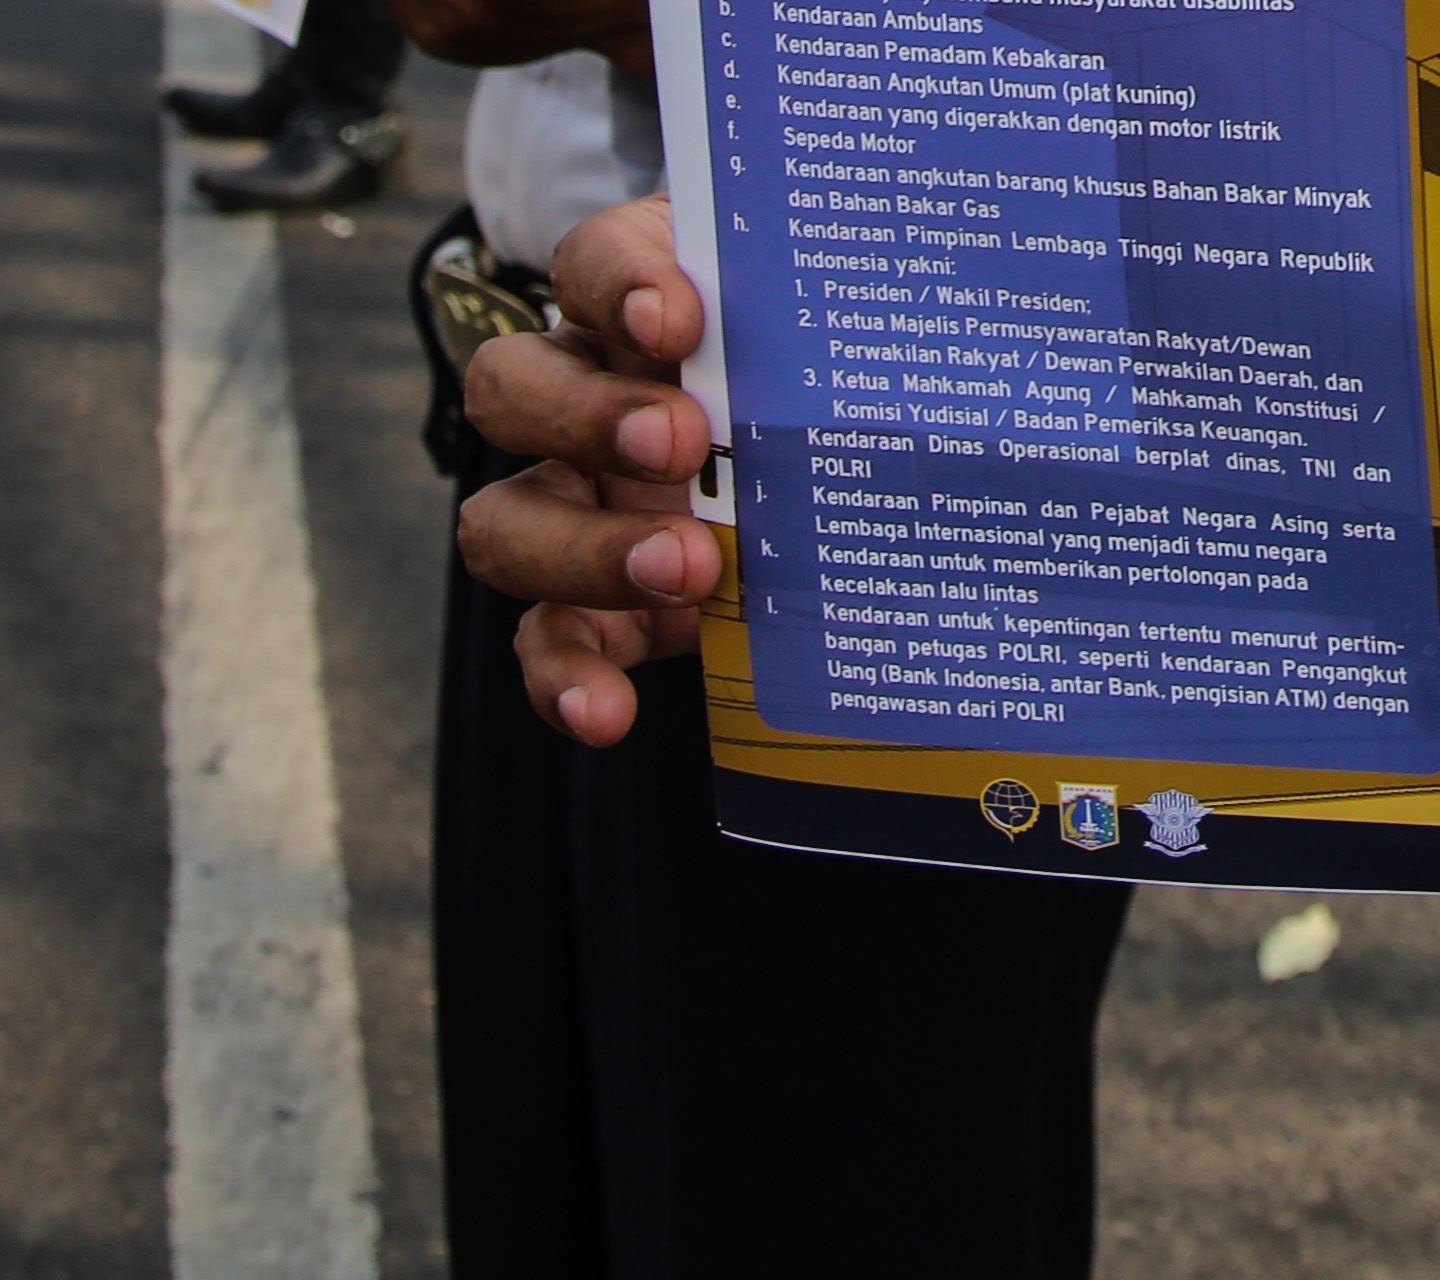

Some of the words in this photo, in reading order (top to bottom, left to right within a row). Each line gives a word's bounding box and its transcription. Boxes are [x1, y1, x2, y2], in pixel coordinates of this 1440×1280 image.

[772, 1, 878, 28] Kendaraan
[882, 9, 984, 34] Ambulans
[774, 32, 880, 60] Kendaraan
[884, 40, 987, 66] Pemadam
[991, 46, 1106, 71] Kebakaran
[776, 64, 882, 91] Kendaraan
[886, 72, 985, 100] Angkutan
[988, 77, 1057, 100] Umum
[1062, 80, 1112, 107] (plat
[1116, 83, 1196, 112] kuning)
[778, 94, 883, 122] Kendaraan
[886, 107, 939, 131] yang
[944, 106, 1061, 133] digerakkan
[1066, 112, 1144, 141] dengan
[1148, 117, 1213, 139] motor
[1218, 118, 1282, 142] listrik
[783, 126, 856, 154] Sepeda
[860, 132, 917, 154] Motor
[784, 156, 891, 183] Kendaraan
[896, 166, 991, 191] angkutan
[995, 170, 1068, 199] barang
[1073, 174, 1148, 198] khusus
[1152, 178, 1219, 202] Bahan
[1223, 182, 1288, 206] Bakar
[1294, 186, 1372, 215] Minyak
[788, 188, 824, 210] dan
[828, 190, 892, 213] Bahan
[895, 194, 957, 217] Bakar
[962, 198, 1001, 219] Gas
[788, 217, 896, 243] Kendaraan
[905, 224, 1002, 252] Pimpinan
[1010, 230, 1108, 261] Lembaga
[1117, 238, 1183, 267] Tinggi
[1193, 242, 1270, 270] Negara
[1279, 248, 1375, 276] Republik
[792, 248, 889, 272] Indonesia
[893, 255, 957, 279] yakni:
[823, 280, 914, 303] Presiden
[935, 285, 991, 308] Wakil
[826, 309, 885, 332] Ketua
[889, 312, 960, 339] Majelis
[964, 316, 1152, 348] Permusyawaratan
[1155, 329, 1312, 360] Rakyat/Dewan
[828, 339, 942, 364] Perwakilan
[946, 345, 1021, 374] Rakyat
[1044, 350, 1114, 374] Dewan
[1118, 355, 1234, 383] Perwakilan
[1324, 372, 1364, 393] dan
[831, 368, 890, 392] Ketua
[902, 372, 1012, 398] Mahkamah
[1024, 380, 1092, 408] Agung
[1130, 385, 1243, 413] Mahkamah
[1254, 395, 1359, 422] Konstitusi
[832, 399, 902, 422] Komisi
[906, 402, 990, 427] Yudisial
[1013, 409, 1079, 431] Badan
[1083, 412, 1196, 438] Pemeriksa
[1200, 420, 1309, 450] Keuangan.
[806, 426, 915, 452] Kendaraan
[928, 434, 985, 456] Dinas
[998, 438, 1120, 464] Operasional
[1134, 445, 1211, 472] berplat
[1300, 457, 1337, 479] TNI
[1352, 462, 1392, 483] dan
[810, 456, 872, 479] POLRI
[812, 485, 920, 511] Kendaraan
[930, 492, 1028, 519] Pimpinan
[1040, 499, 1079, 520] dan
[1090, 502, 1170, 528] Pejabat
[1182, 506, 1257, 533] Negara
[1270, 512, 1329, 541] Asing
[1342, 521, 1396, 541] serta
[814, 514, 909, 544] Lembaga
[914, 520, 1045, 547] Internasional
[1049, 532, 1102, 556] yang
[1107, 534, 1191, 558] menjadi
[1195, 536, 1250, 558] tamu
[1254, 544, 1328, 567] negara
[817, 544, 925, 569] Kendaraan
[929, 552, 988, 573] untuk
[992, 557, 1123, 580] memberikan
[1127, 564, 1252, 592] pertolongan
[1256, 572, 1309, 594] pada
[820, 573, 936, 599] kecelakaan
[940, 580, 978, 601] lalu
[982, 582, 1040, 604] lintas
[822, 601, 930, 627] Kendaraan
[937, 611, 996, 631] untuk
[1003, 612, 1131, 643] kepentingan
[1138, 620, 1222, 644] tertentu
[1230, 630, 1318, 651] menurut
[1327, 634, 1406, 657] pertim-
[824, 630, 897, 658] bangan
[907, 638, 988, 664] petugas
[1078, 650, 1150, 672] seperti
[1160, 651, 1271, 677] kendaraan
[1282, 658, 1408, 688] Pengangkut
[830, 692, 952, 716] pengawasan
[956, 698, 997, 719] dari
[1002, 700, 1065, 723] POLRI
